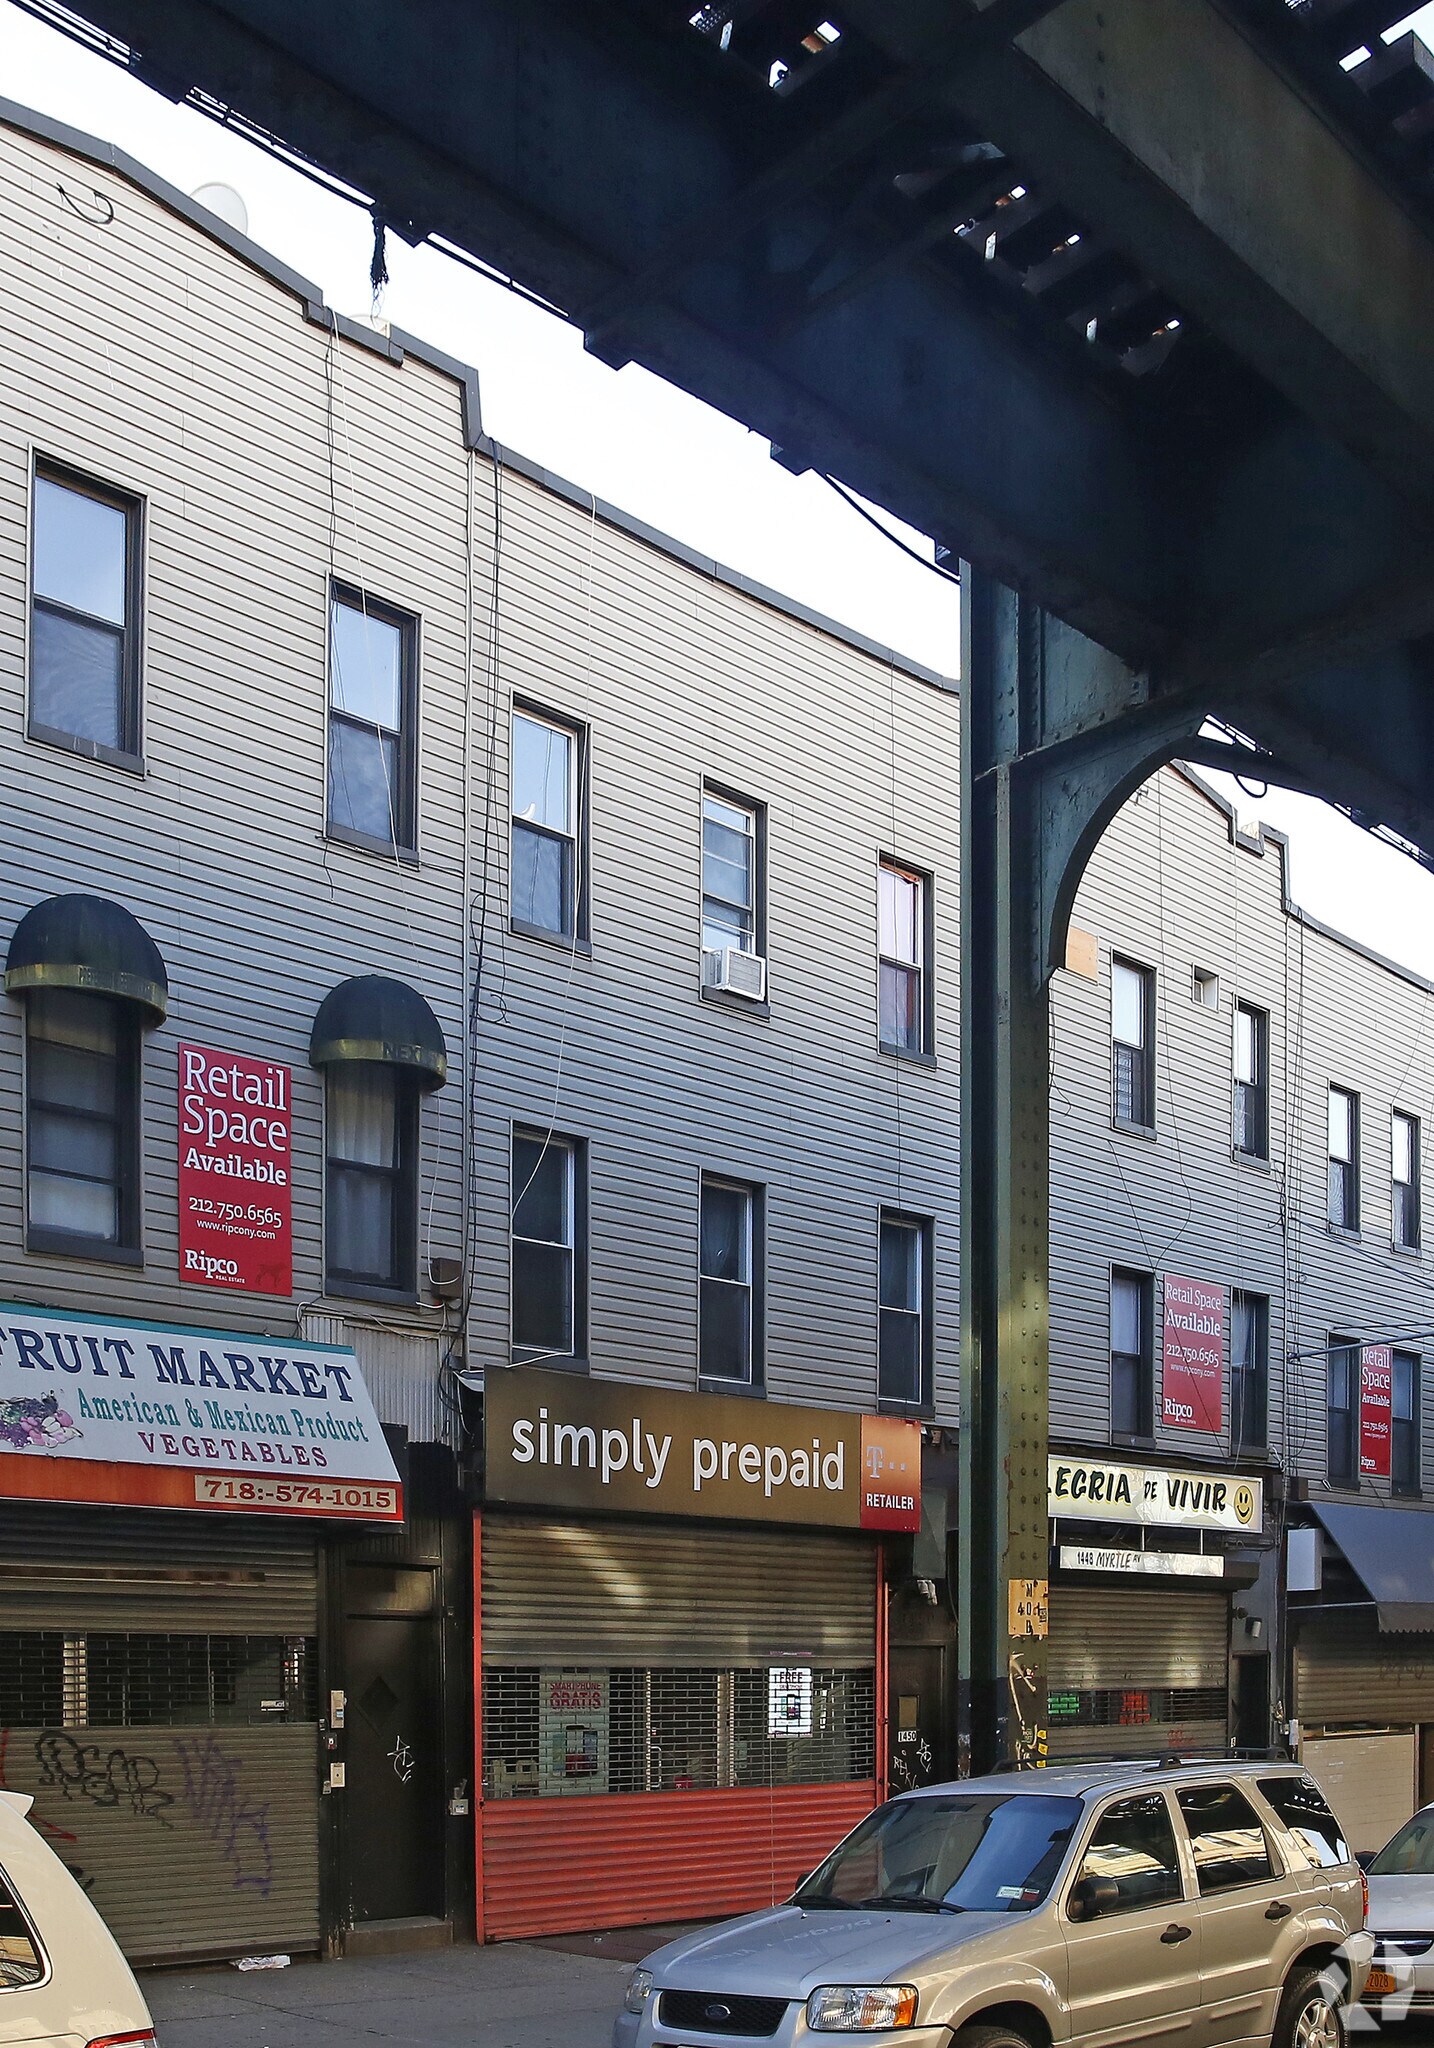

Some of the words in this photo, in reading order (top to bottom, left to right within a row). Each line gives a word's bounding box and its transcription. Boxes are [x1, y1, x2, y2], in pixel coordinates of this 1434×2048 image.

[183, 1050, 287, 1111] Retail
[183, 1094, 287, 1151] Space
[183, 1147, 287, 1187] Available
[188, 1197, 282, 1229] 212.750.6565
[196, 1219, 276, 1240] www.ripcony.com
[184, 1249, 238, 1279] Ripco
[1166, 1282, 1193, 1305] Retail
[1194, 1289, 1221, 1311] Space
[1165, 1308, 1221, 1337] Available
[0, 1326, 136, 1379] RUIT
[146, 1343, 354, 1402] MARKET
[1166, 1343, 1219, 1368] 212.750.6565
[1362, 1346, 1390, 1369] Retail
[1362, 1367, 1390, 1391] Space
[78, 1387, 181, 1427] American
[186, 1398, 204, 1430] &
[204, 1400, 292, 1437] Mexican
[290, 1407, 369, 1443] Product
[1164, 1398, 1193, 1422] Ripco
[1362, 1393, 1390, 1408] Available
[138, 1431, 328, 1467] VEGETABLES
[511, 1407, 673, 1489] simply
[692, 1437, 845, 1498] prepaid
[866, 1492, 914, 1511] RETAILER
[1047, 1465, 1132, 1504] EGRIA
[1144, 1480, 1158, 1500] DE
[1166, 1478, 1227, 1514] VIVIR
[1095, 1551, 1132, 1569] MYRTLE
[779, 1671, 804, 1683] FREE
[549, 1691, 602, 1710] GRATIS
[898, 1731, 917, 1741] 1450
